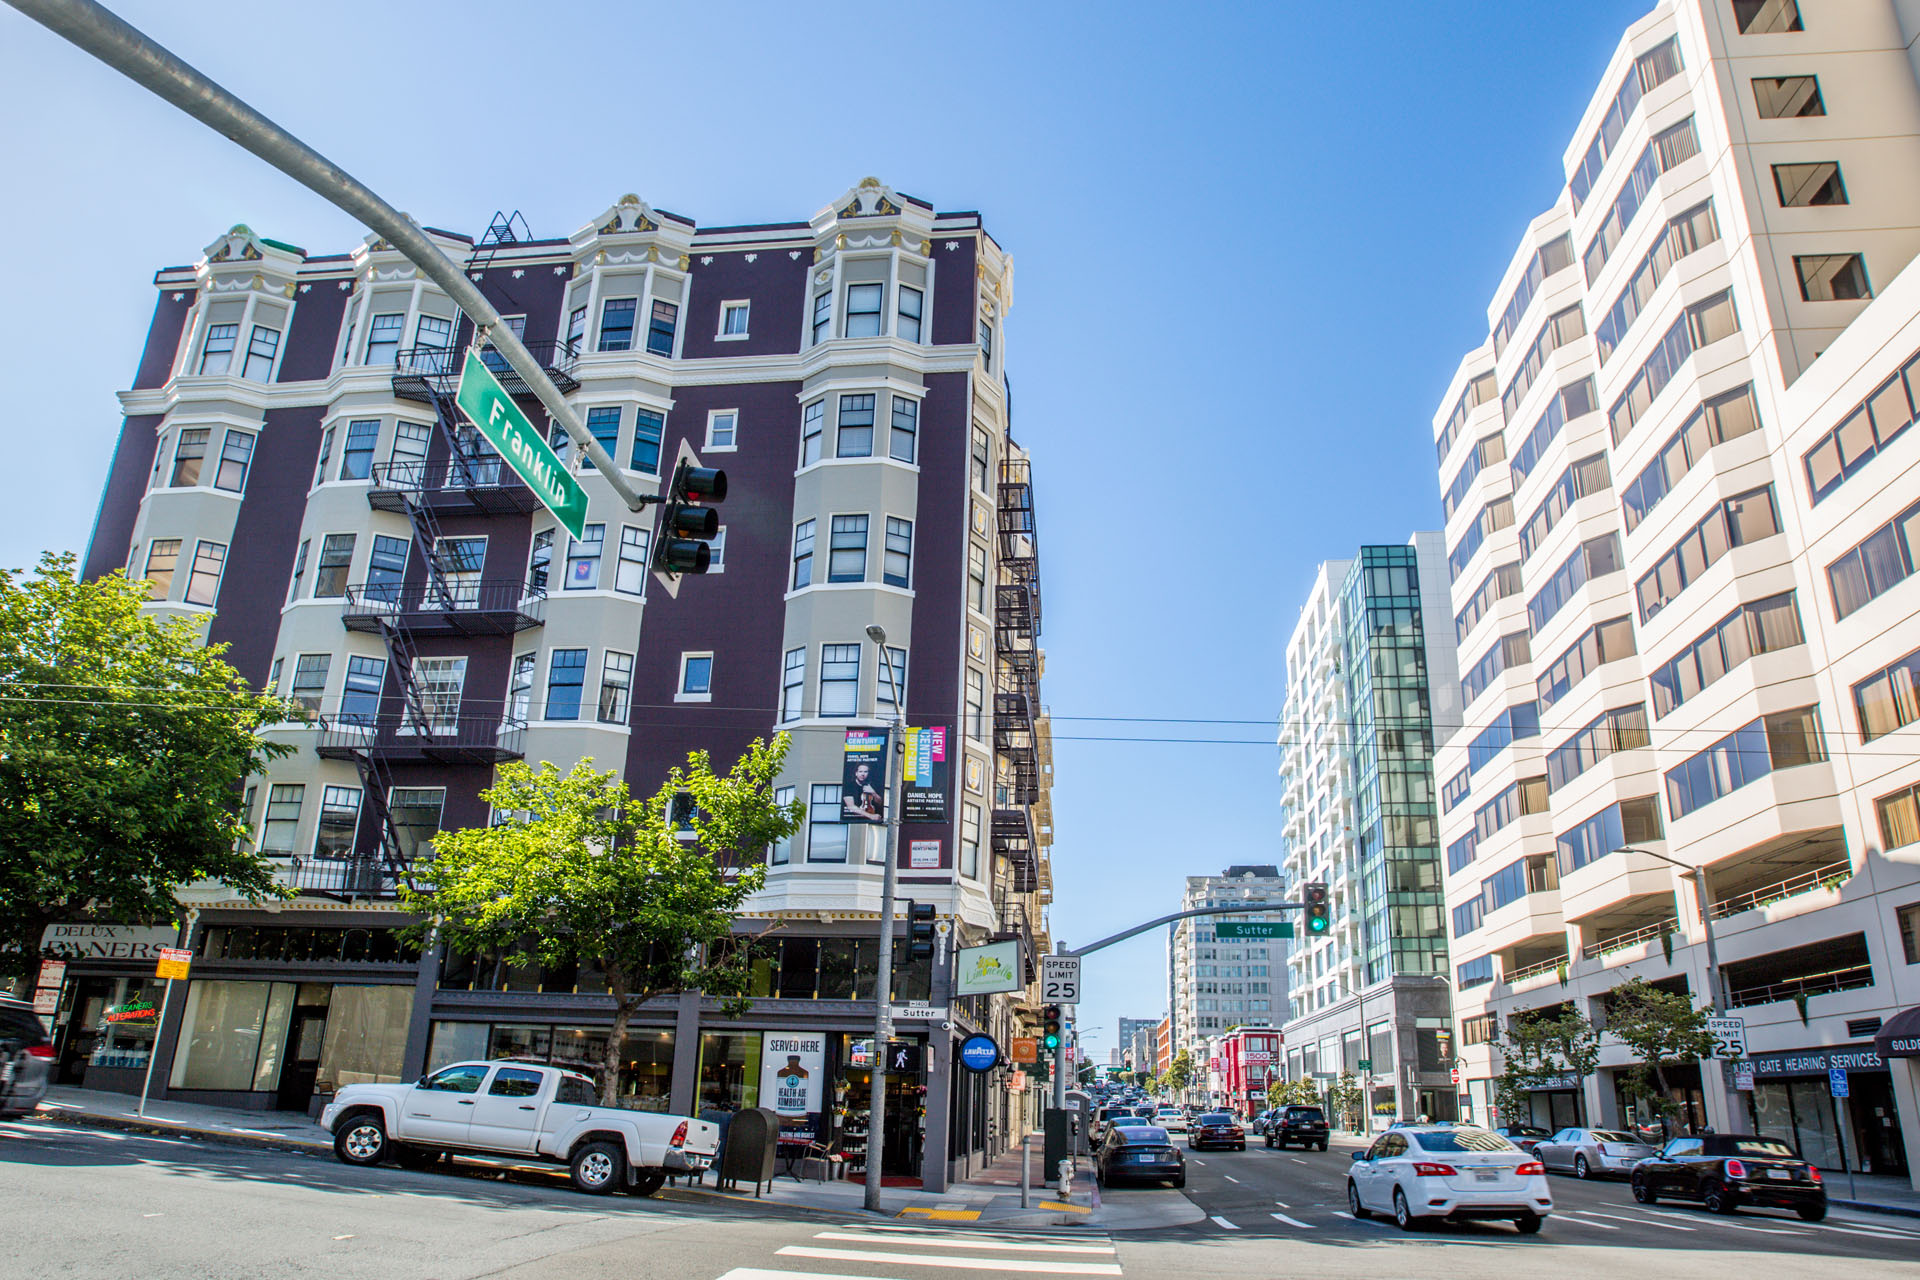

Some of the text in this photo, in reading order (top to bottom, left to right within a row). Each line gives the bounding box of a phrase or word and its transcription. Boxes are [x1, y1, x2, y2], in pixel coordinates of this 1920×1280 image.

[489, 397, 567, 507] Franklin
[932, 731, 943, 755] NEW
[919, 731, 931, 777] CENTURY
[1236, 925, 1273, 935] Sutter
[1046, 961, 1078, 969] SPEED
[1048, 971, 1074, 979] LIMIT
[1046, 982, 1076, 998] 25
[106, 1008, 156, 1022] ALTERATIONS
[903, 1009, 936, 1017] Sutter
[1711, 1020, 1741, 1028] SPEED
[770, 1039, 820, 1053] SERVED HERE
[964, 1046, 995, 1056] LAVAZZA
[1714, 1040, 1744, 1056] 25
[1246, 1052, 1268, 1060] 1500
[1759, 1059, 1782, 1073] GATE
[1785, 1056, 1826, 1071] HEARING
[1830, 1052, 1882, 1069] SERVICES
